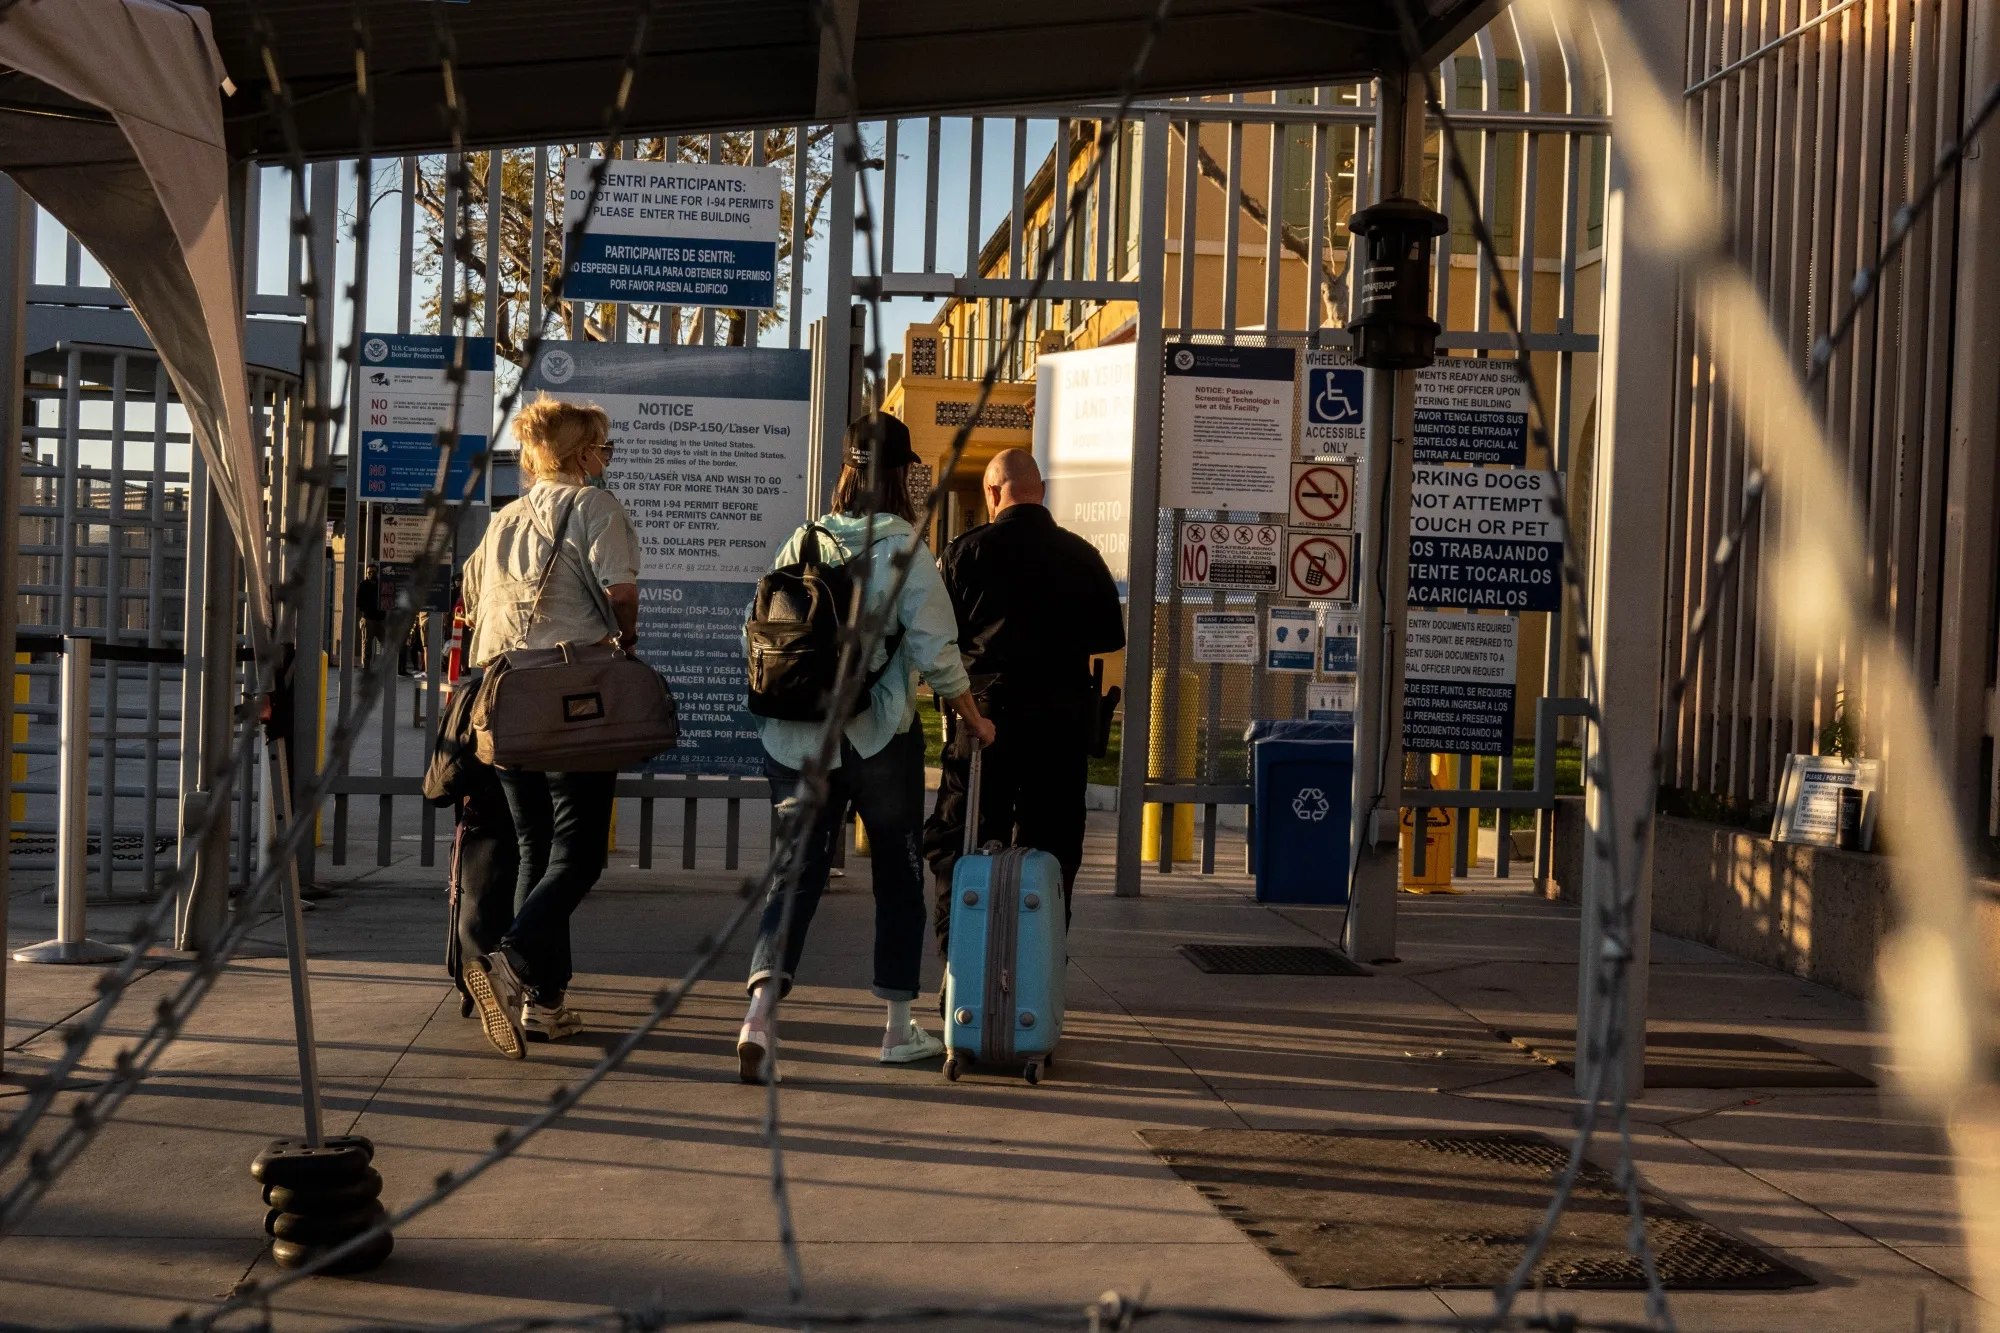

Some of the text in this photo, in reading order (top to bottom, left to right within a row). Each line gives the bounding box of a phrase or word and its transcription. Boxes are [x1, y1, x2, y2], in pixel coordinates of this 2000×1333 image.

[601, 174, 746, 192] SENTRI PARTICIPANTS:
[571, 190, 773, 209] DO OT WAIT IN LINE FOR I-94 PERMITS
[594, 207, 750, 223] PLEASE ENTER THE BUILDING
[606, 246, 735, 263] PARTICIPANTES DE SENTRI:
[582, 263, 617, 274] ESPEREN
[620, 265, 630, 275] EN
[632, 265, 643, 275] LA
[644, 266, 660, 276] FILA
[663, 267, 683, 277] PARA
[685, 268, 721, 279] OBTENER
[724, 269, 734, 279] SU
[737, 270, 771, 281] PERMISO
[610, 279, 727, 294] POR FAVOR PASEN AL EDIFICIO
[1306, 354, 1356, 366] WHEELCH
[1439, 360, 1460, 368] HAVE
[1463, 361, 1487, 369] YOUR
[1450, 372, 1478, 381] READY
[1480, 374, 1498, 382] AND
[1424, 384, 1435, 392] TO
[1438, 385, 1454, 393] THE
[1457, 386, 1493, 395] OFFICER
[1497, 388, 1520, 396] UPON
[371, 399, 387, 409] NO
[1196, 395, 1230, 403] Screening
[1233, 396, 1270, 405] Technology
[1452, 398, 1468, 406] THE
[1471, 399, 1511, 408] BUILDING
[639, 403, 693, 416] NOTICE
[371, 415, 387, 425] NO
[1414, 411, 1523, 424] FAVOR TENGA LISTOS SUS
[633, 420, 665, 430] Cards
[670, 421, 759, 434] (DSP-150/Laser
[764, 425, 790, 436] Visa)
[1306, 427, 1365, 439] ACCESSIBLE
[1415, 424, 1519, 436] UMENTOS DE ENTRADA Y
[1323, 442, 1347, 453] ONLY
[1460, 439, 1470, 447] AL
[1473, 439, 1505, 449] OFICIAL
[1508, 441, 1518, 449] AL
[1414, 450, 1500, 461] ENTRAR AL EDIFICIO
[712, 459, 738, 467] border.
[682, 474, 700, 482] VISA
[728, 475, 750, 483] WISH
[754, 476, 765, 484] TO
[769, 476, 781, 484] GO
[1412, 471, 1540, 489] RKING DOGS
[623, 482, 635, 490] OR
[639, 483, 659, 491] STAY
[664, 483, 681, 492] FOR
[685, 484, 711, 493] MORE
[715, 485, 738, 493] THAN
[742, 486, 753, 494] 30
[757, 486, 779, 495] DAYS
[634, 499, 660, 507] FORM
[664, 500, 680, 508] I-94
[684, 501, 718, 509] PERMIT
[723, 502, 758, 510] BEFORE
[1411, 494, 1542, 513] NOT ATTEMPT
[646, 510, 663, 518] I-94
[667, 511, 707, 519] PERMITS
[1075, 501, 1121, 522] PUERTO
[646, 521, 670, 529] PORT
[673, 521, 685, 529] OF
[689, 522, 719, 530] ENTRY.
[1478, 520, 1505, 534] OR
[1512, 521, 1548, 536] PET
[384, 533, 395, 544] NO
[643, 537, 659, 545] U.S.
[663, 538, 704, 546] DOLLARS
[730, 540, 766, 548] PERSON
[1091, 533, 1128, 553] YSIDR
[383, 548, 395, 558] NO
[679, 549, 719, 557] MONTHS.
[1440, 543, 1548, 561] TRABAJANDO
[1183, 544, 1208, 581] NO
[1466, 566, 1551, 584] TOCARLOS
[639, 588, 683, 601] AVISO
[1408, 586, 1528, 605] ACARICIARLOS
[1409, 619, 1511, 633] ENTRY DOCUMENTS REQUIRED
[1421, 664, 1450, 673] OFFICER
[1452, 666, 1471, 675] UPON
[1473, 667, 1504, 676] REQUEST
